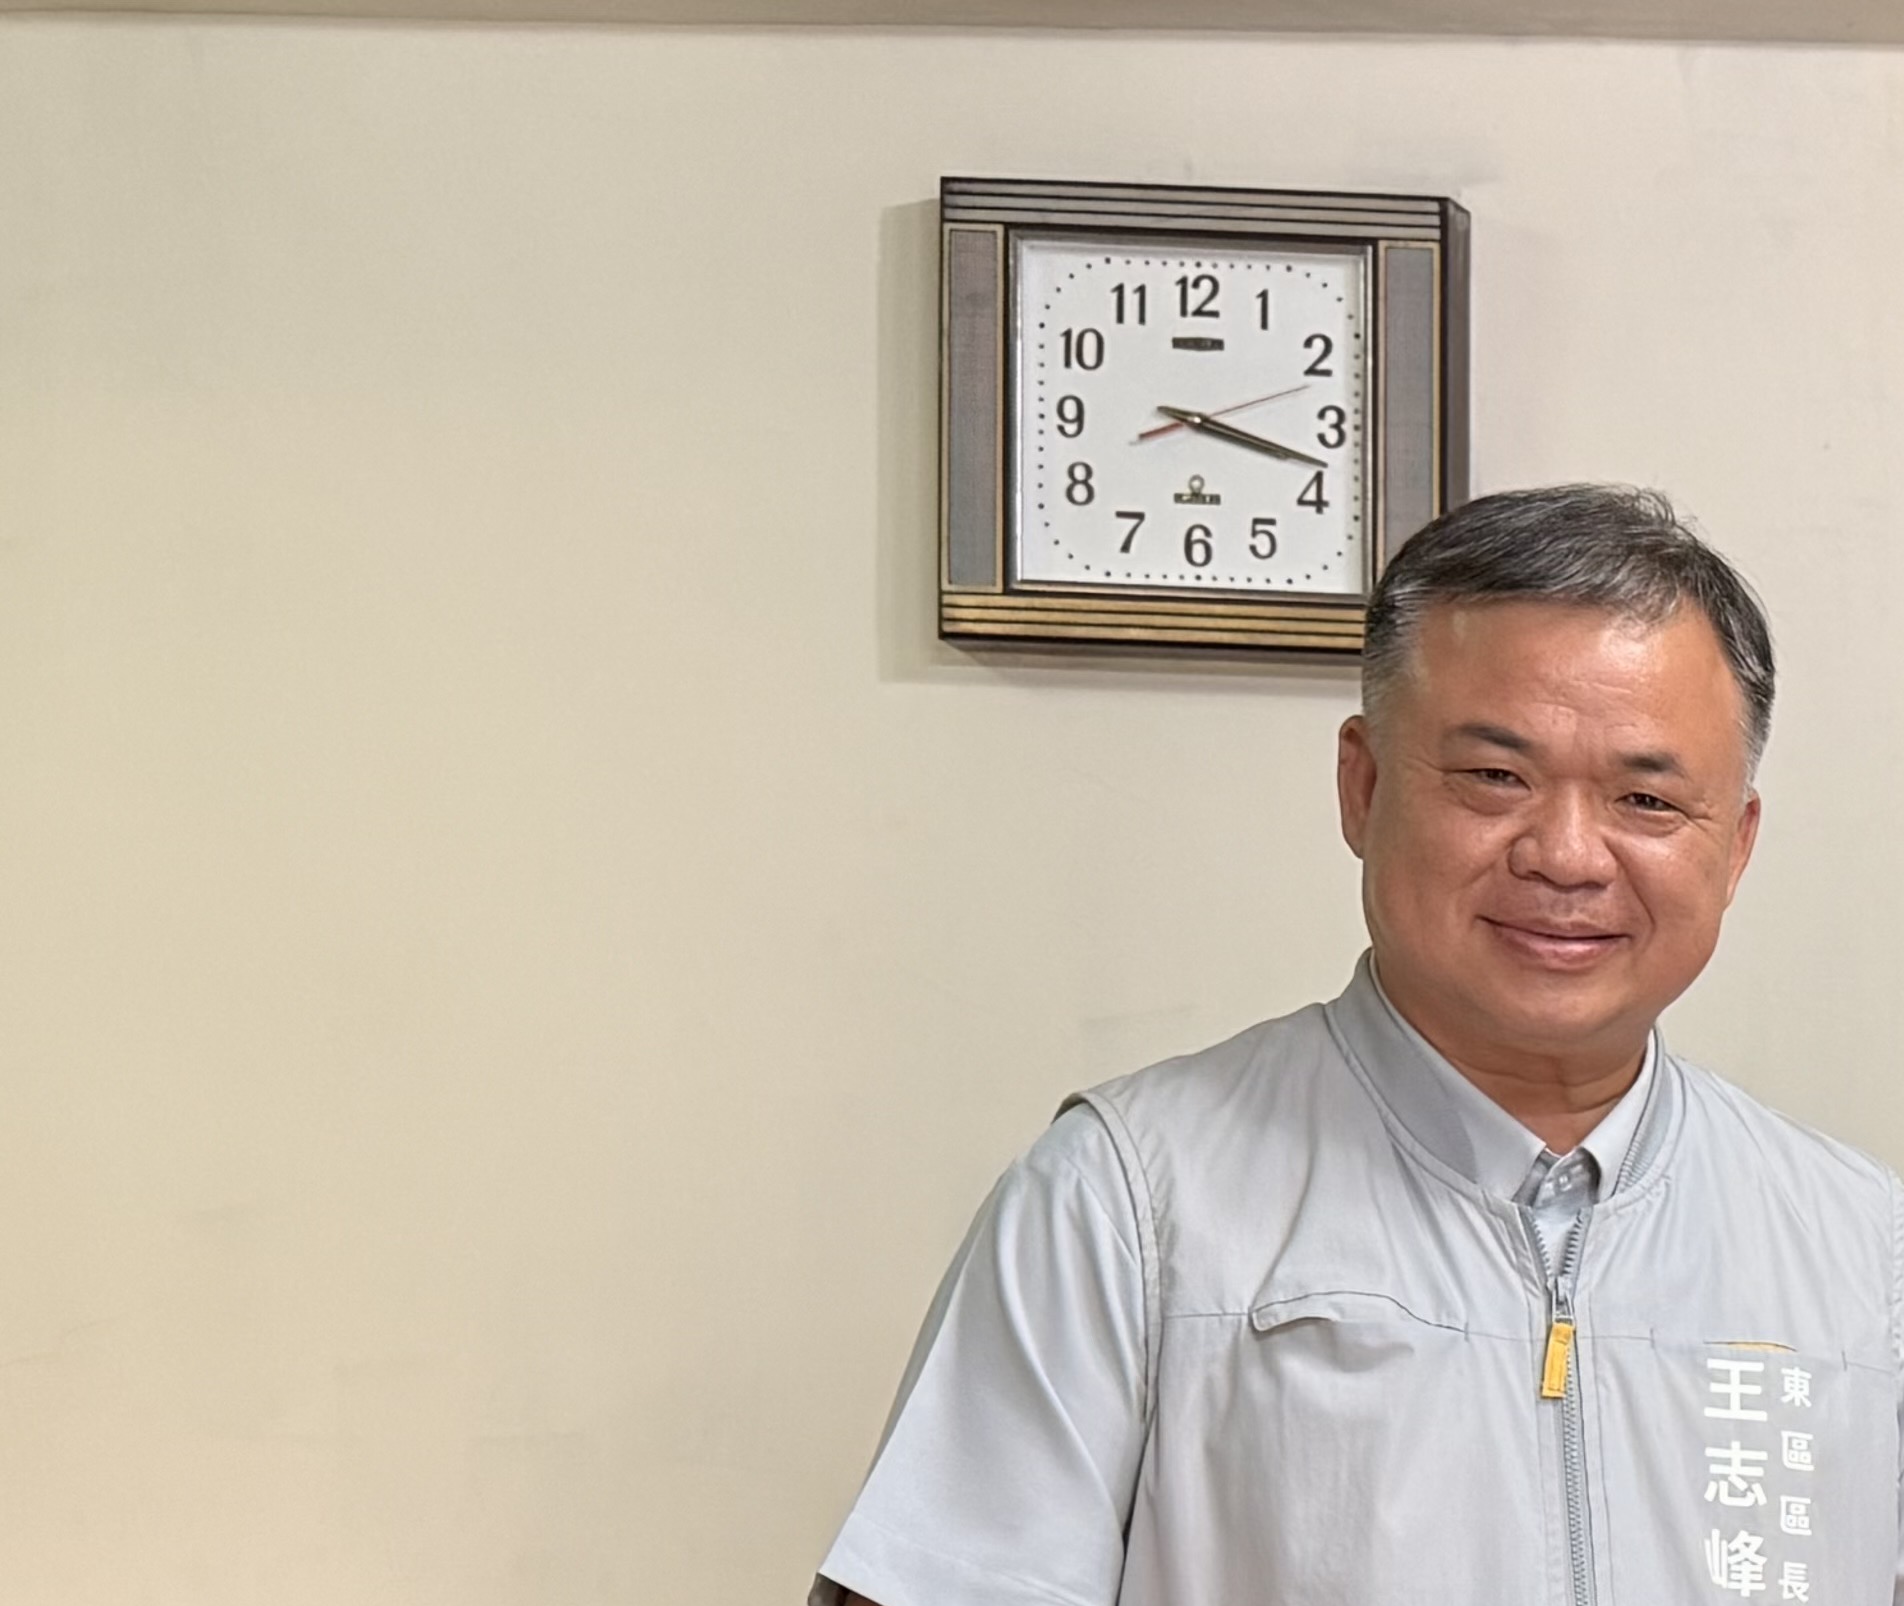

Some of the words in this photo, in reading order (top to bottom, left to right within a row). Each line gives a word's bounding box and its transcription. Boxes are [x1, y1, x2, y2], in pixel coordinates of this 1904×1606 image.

[1111, 283, 1146, 326] 11
[1175, 274, 1221, 319] 12
[1256, 289, 1271, 331] 1
[1060, 328, 1105, 371] 10
[1303, 334, 1333, 377] 2
[1056, 395, 1085, 438] 9
[1316, 405, 1347, 449] 3
[1065, 462, 1095, 506] 8
[1297, 471, 1330, 515] 4
[1115, 511, 1145, 554] 7
[1184, 524, 1212, 567] 6
[1249, 517, 1277, 559] 5
[1703, 1357, 1768, 1598] 王志峰
[1778, 1366, 1815, 1603] 東區區長
